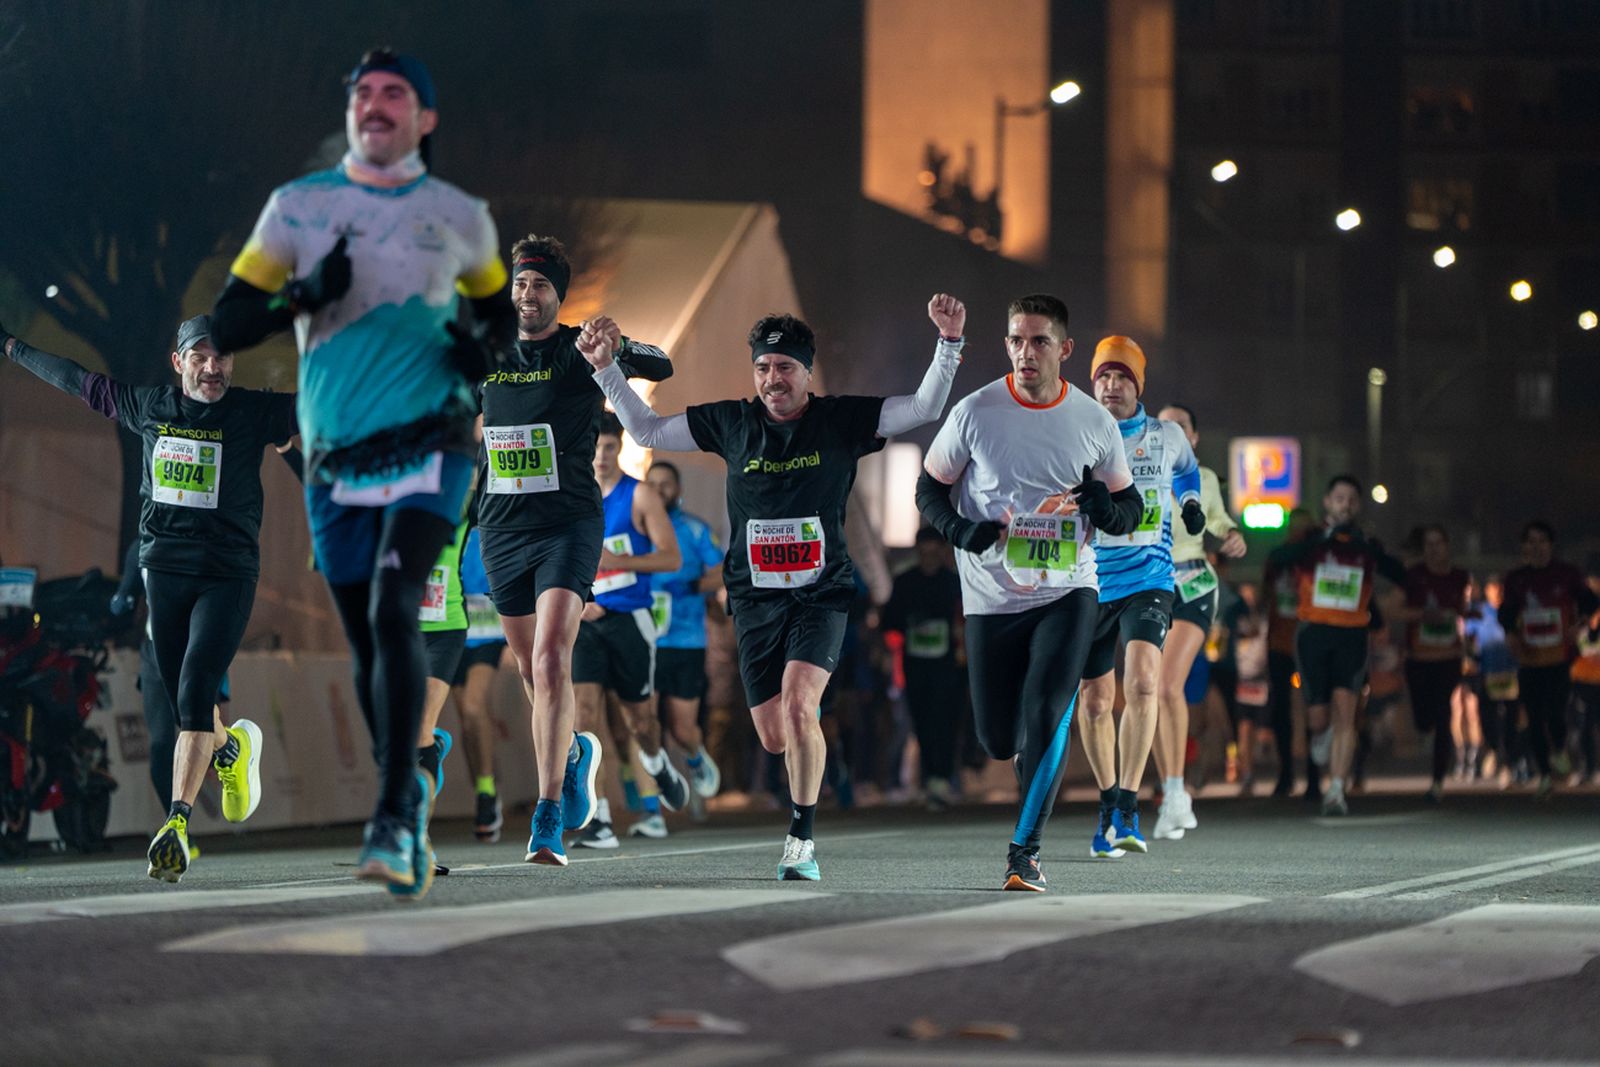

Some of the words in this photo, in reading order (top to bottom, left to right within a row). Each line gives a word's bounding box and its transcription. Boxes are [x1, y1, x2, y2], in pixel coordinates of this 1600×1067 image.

[498, 368, 552, 384] personal
[169, 426, 222, 440] personal
[497, 449, 542, 471] 9979
[763, 451, 821, 473] personal
[163, 460, 205, 485] 9974
[1128, 465, 1163, 477] CENA
[1244, 443, 1285, 494] P
[763, 527, 785, 535] NOCHE
[786, 526, 795, 534] DE
[1014, 528, 1029, 537] SAN
[1023, 520, 1046, 529] NOCHE
[755, 535, 769, 544] SAN
[761, 542, 812, 565] 9962
[1027, 539, 1061, 562] 704
